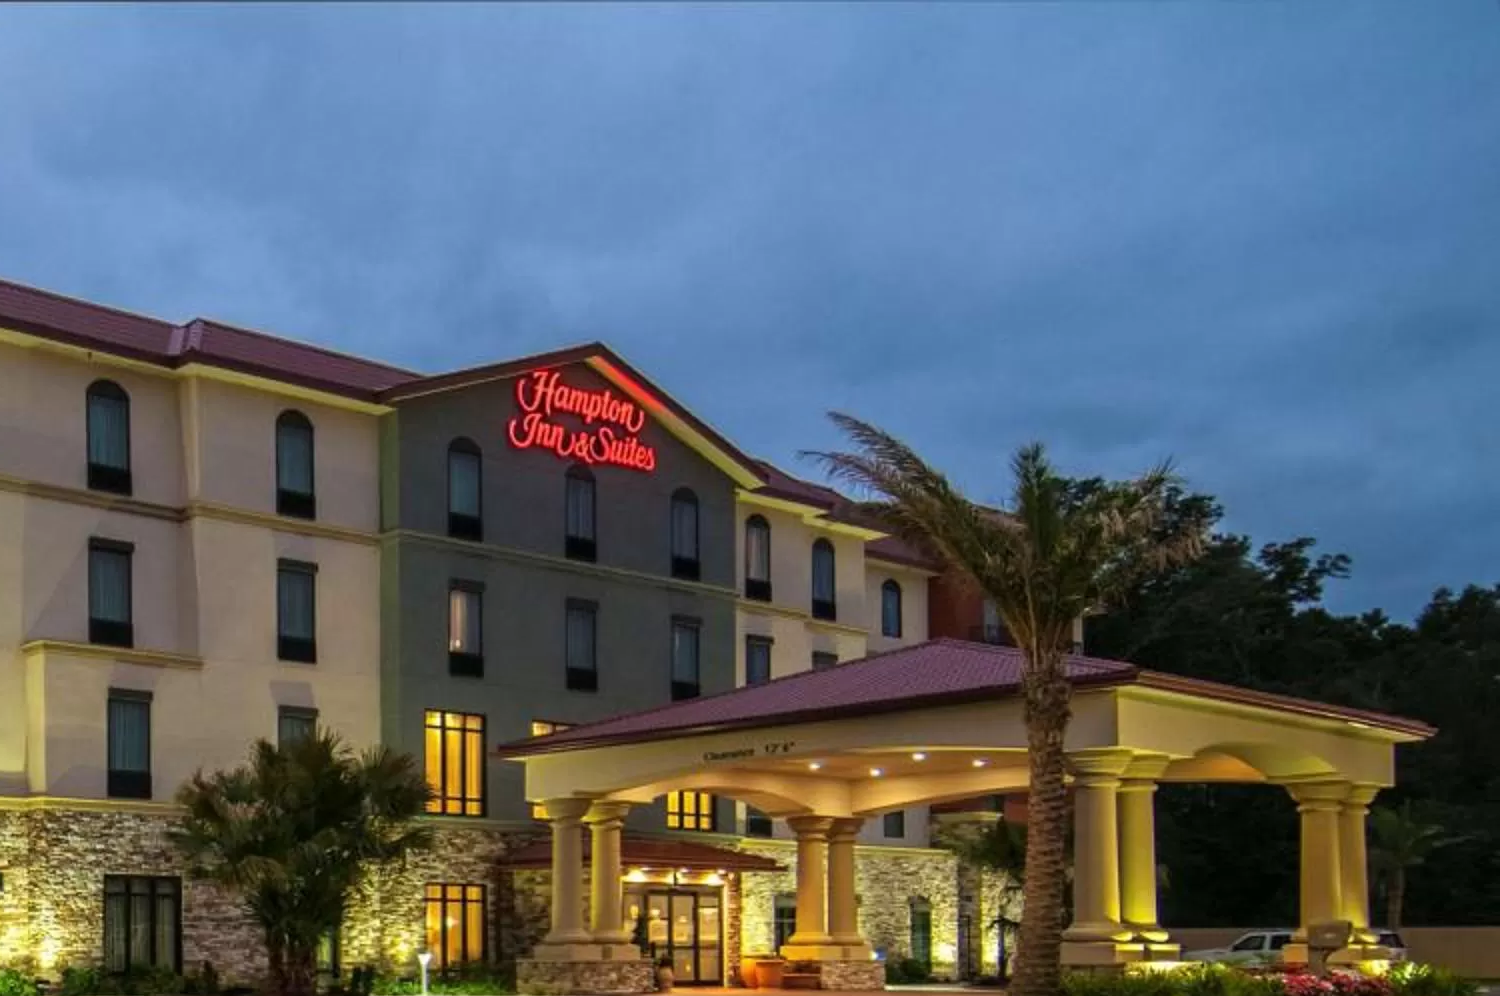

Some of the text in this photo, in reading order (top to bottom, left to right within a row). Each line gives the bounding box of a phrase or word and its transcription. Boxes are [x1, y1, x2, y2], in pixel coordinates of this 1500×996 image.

[518, 371, 644, 432] Hampton
[509, 413, 655, 470] Inn & Suites
